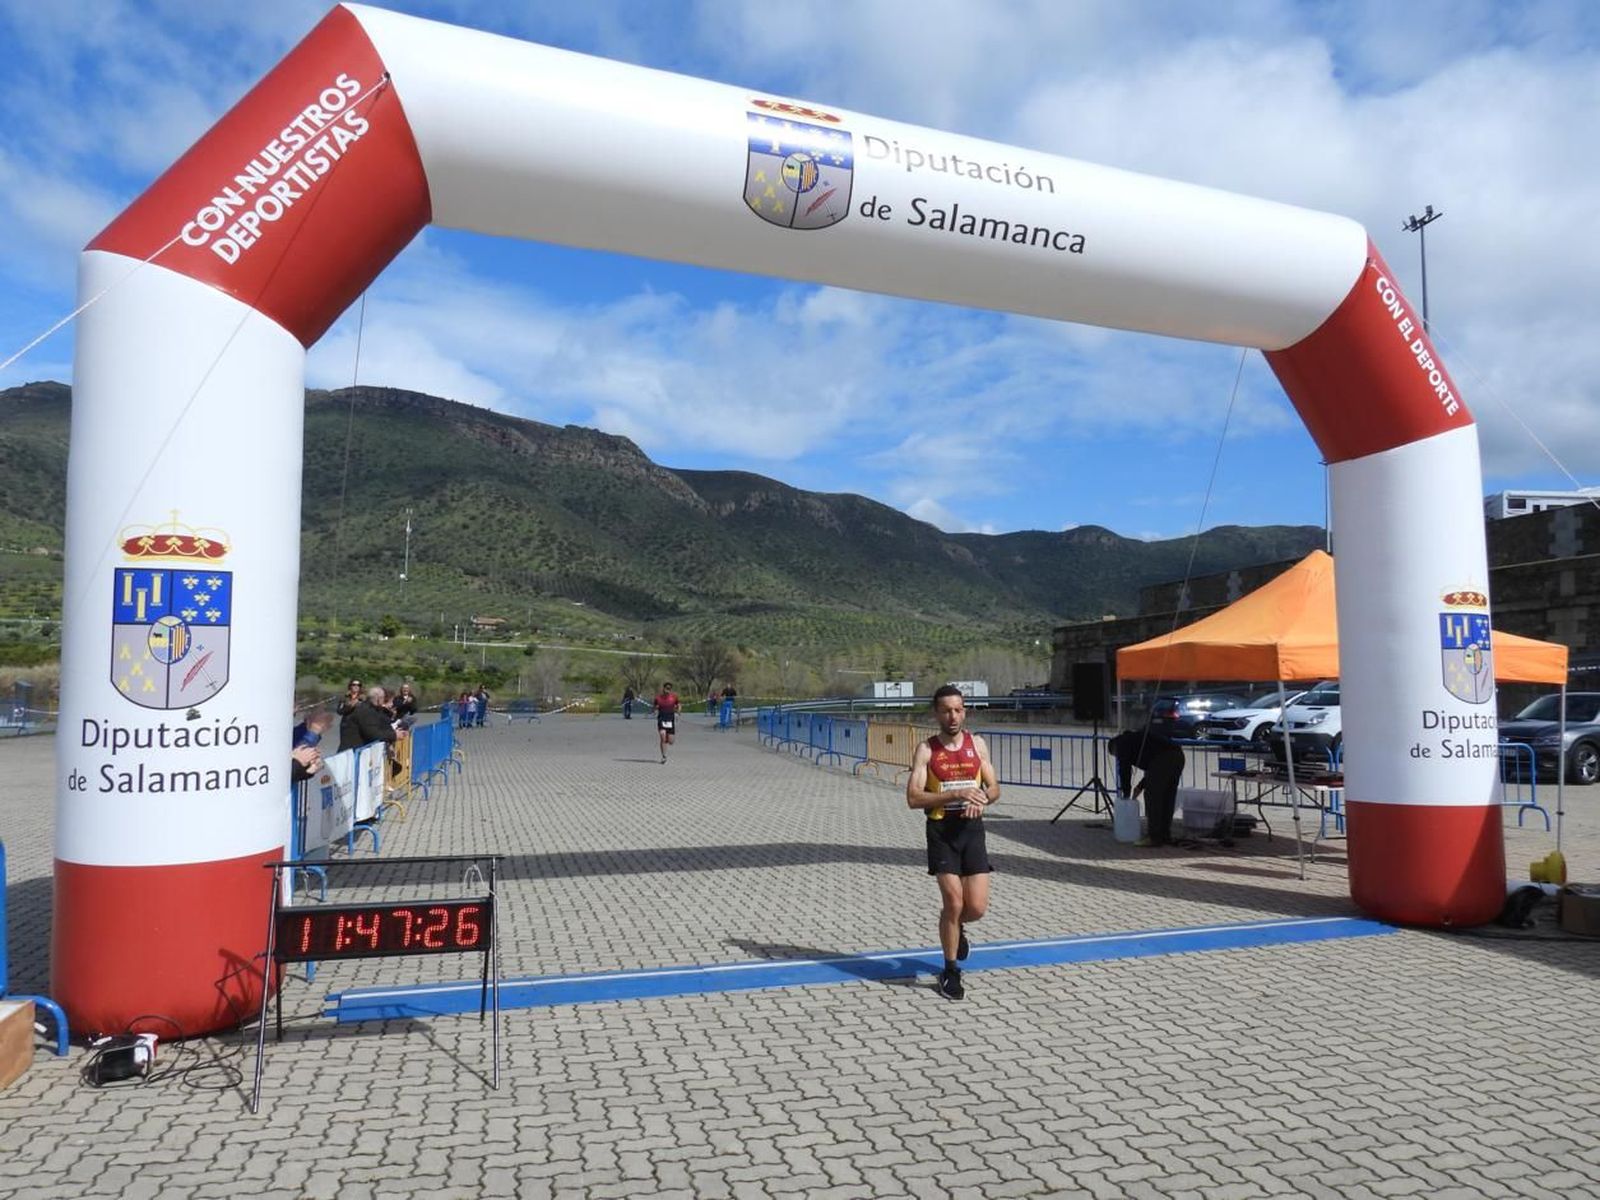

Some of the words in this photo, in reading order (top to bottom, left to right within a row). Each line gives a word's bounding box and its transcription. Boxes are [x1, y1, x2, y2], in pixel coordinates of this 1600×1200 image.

[181, 187, 246, 246] CON
[234, 73, 361, 194] NUESTROS
[210, 109, 370, 265] DEPORTISTAS
[864, 134, 1056, 194] Diputación
[860, 196, 892, 221] de
[907, 197, 1086, 254] Salamanca
[1376, 277, 1404, 320] CON
[1398, 317, 1415, 341] EL
[1410, 338, 1459, 416] DEPORTE
[81, 717, 259, 755] Diputación
[1410, 743, 1431, 758] de
[68, 768, 87, 792] de
[99, 763, 270, 793] Salamanca
